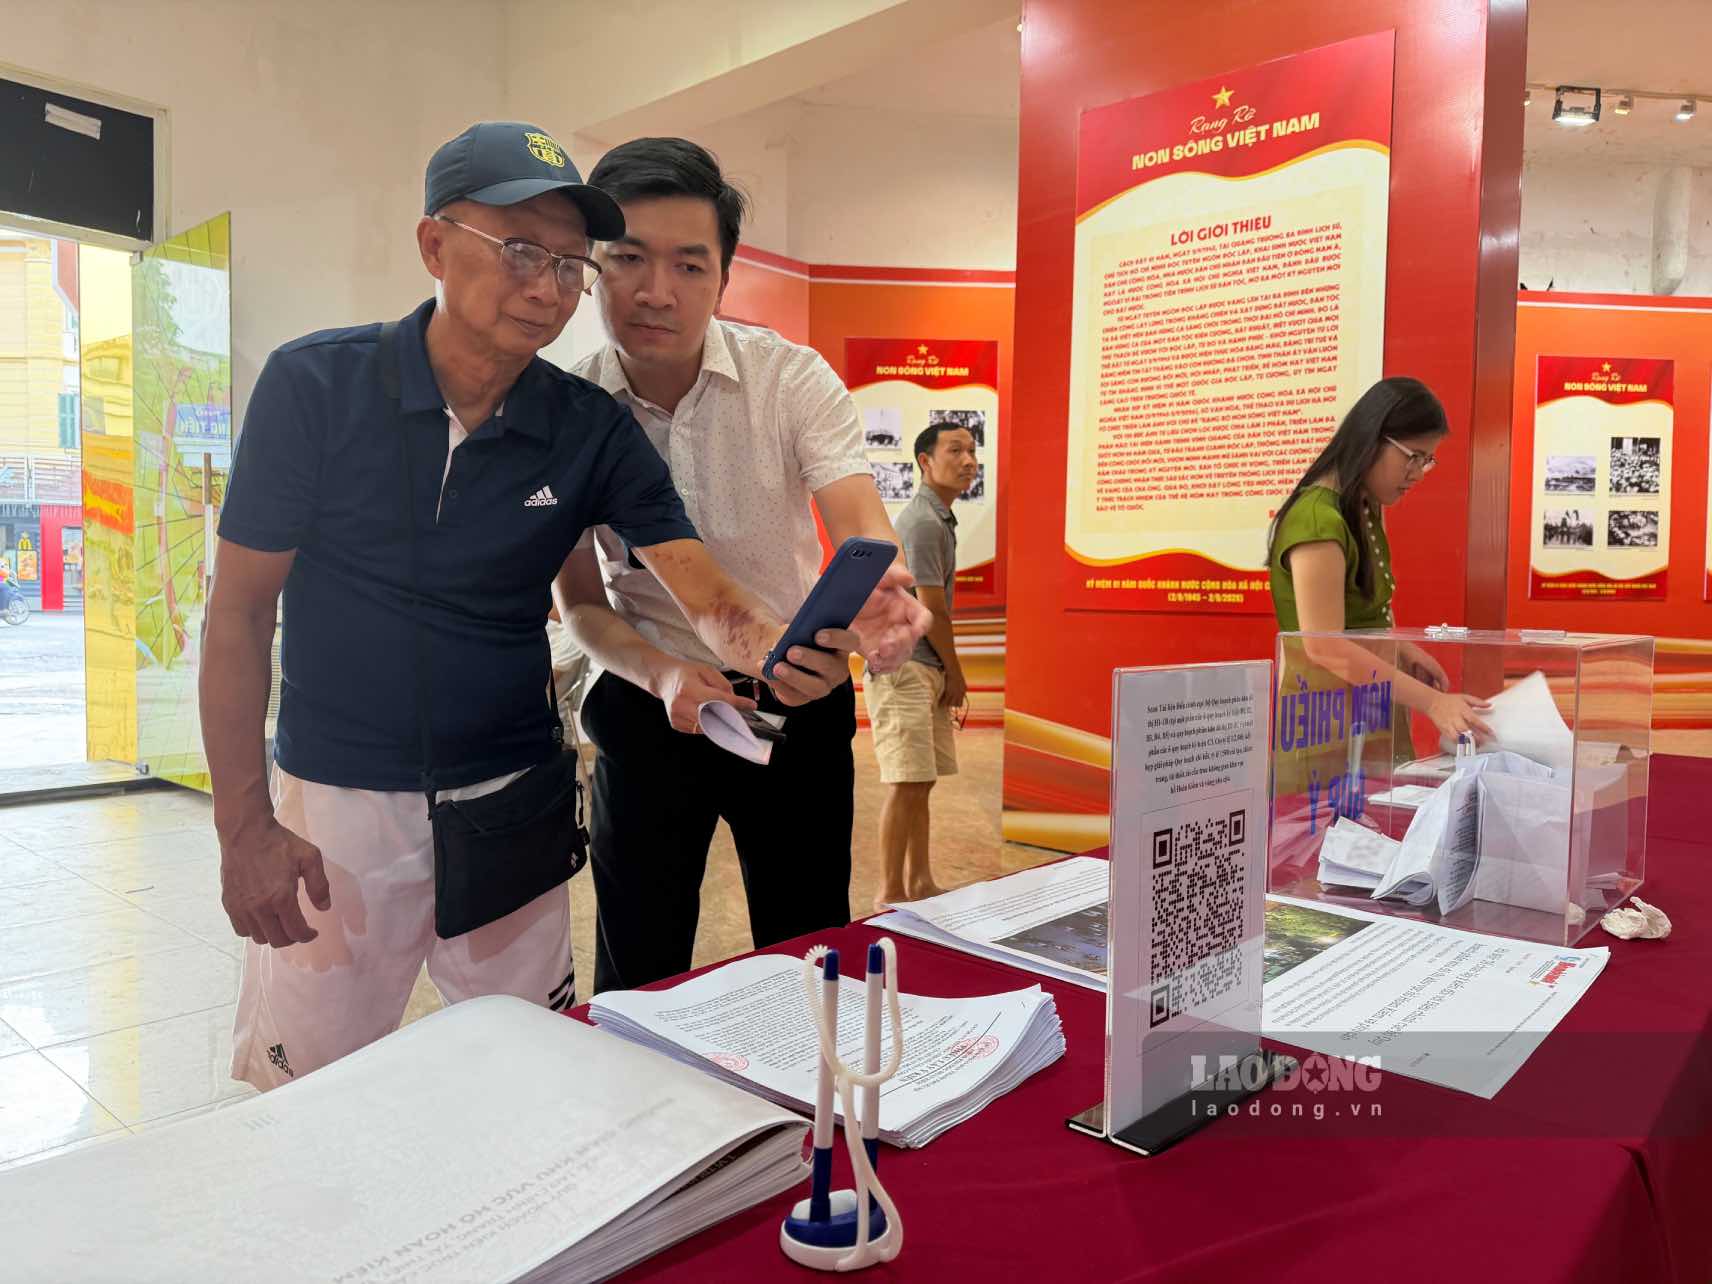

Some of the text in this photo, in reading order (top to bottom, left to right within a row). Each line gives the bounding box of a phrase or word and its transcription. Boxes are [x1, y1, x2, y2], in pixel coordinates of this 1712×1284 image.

[1131, 111, 1321, 171] NON SÔNG VIỆT NAM
[1170, 214, 1272, 247] LỜI GIỚI THIỆU
[876, 365, 897, 376] NON
[946, 366, 970, 377] NAM
[1564, 382, 1583, 392] NON
[1627, 383, 1648, 393] NAM
[524, 497, 558, 507] adidas
